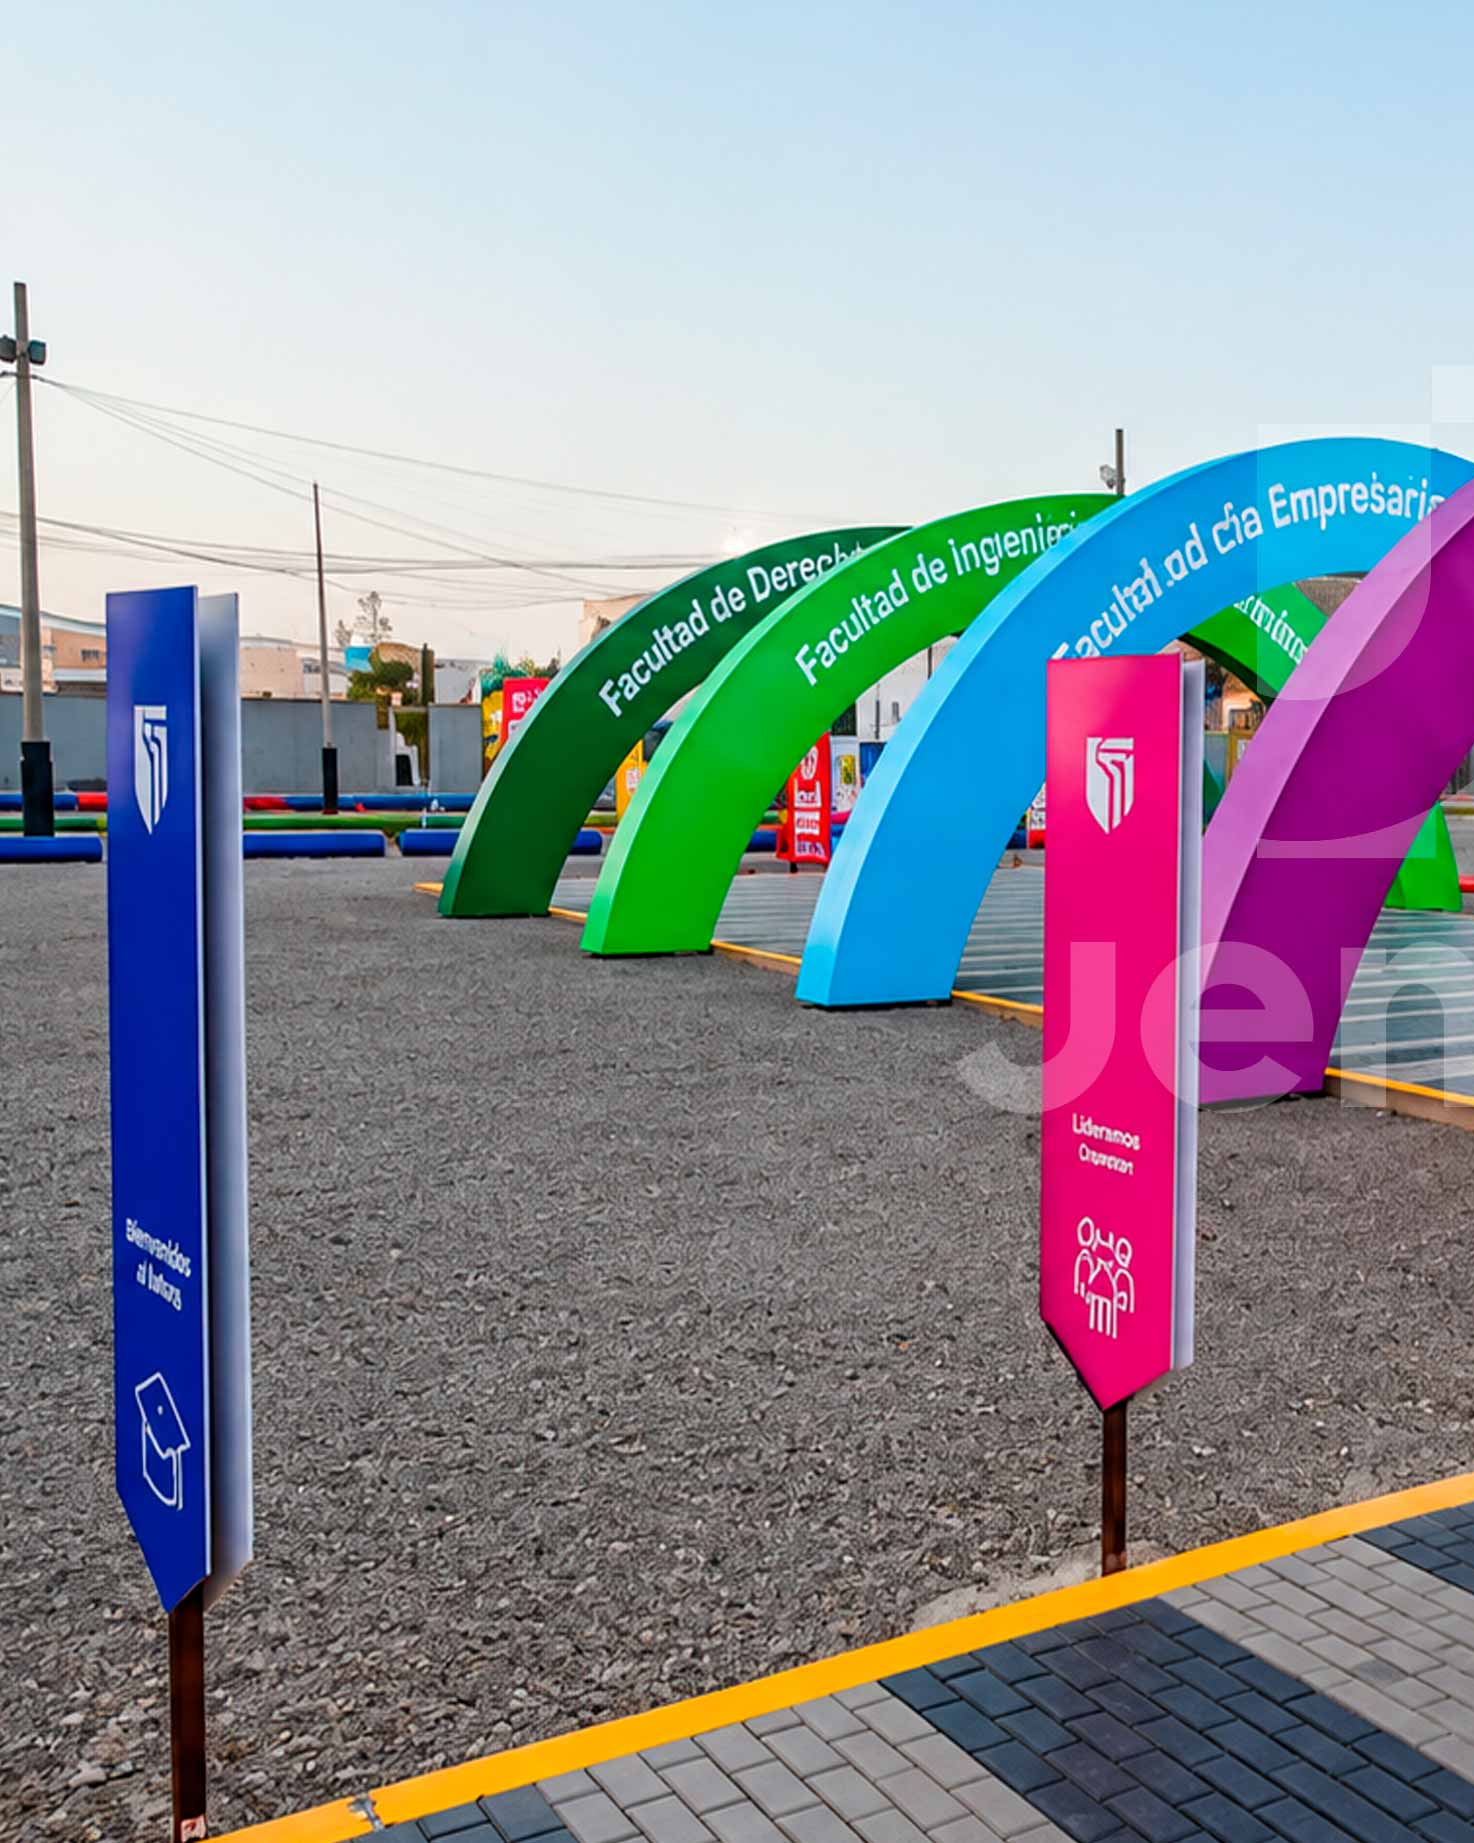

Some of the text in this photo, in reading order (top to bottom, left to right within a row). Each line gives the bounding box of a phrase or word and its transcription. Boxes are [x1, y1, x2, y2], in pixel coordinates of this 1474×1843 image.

[598, 598, 710, 718] Facultad
[710, 584, 747, 623] de
[794, 568, 909, 687] Facultad
[911, 552, 948, 594] de
